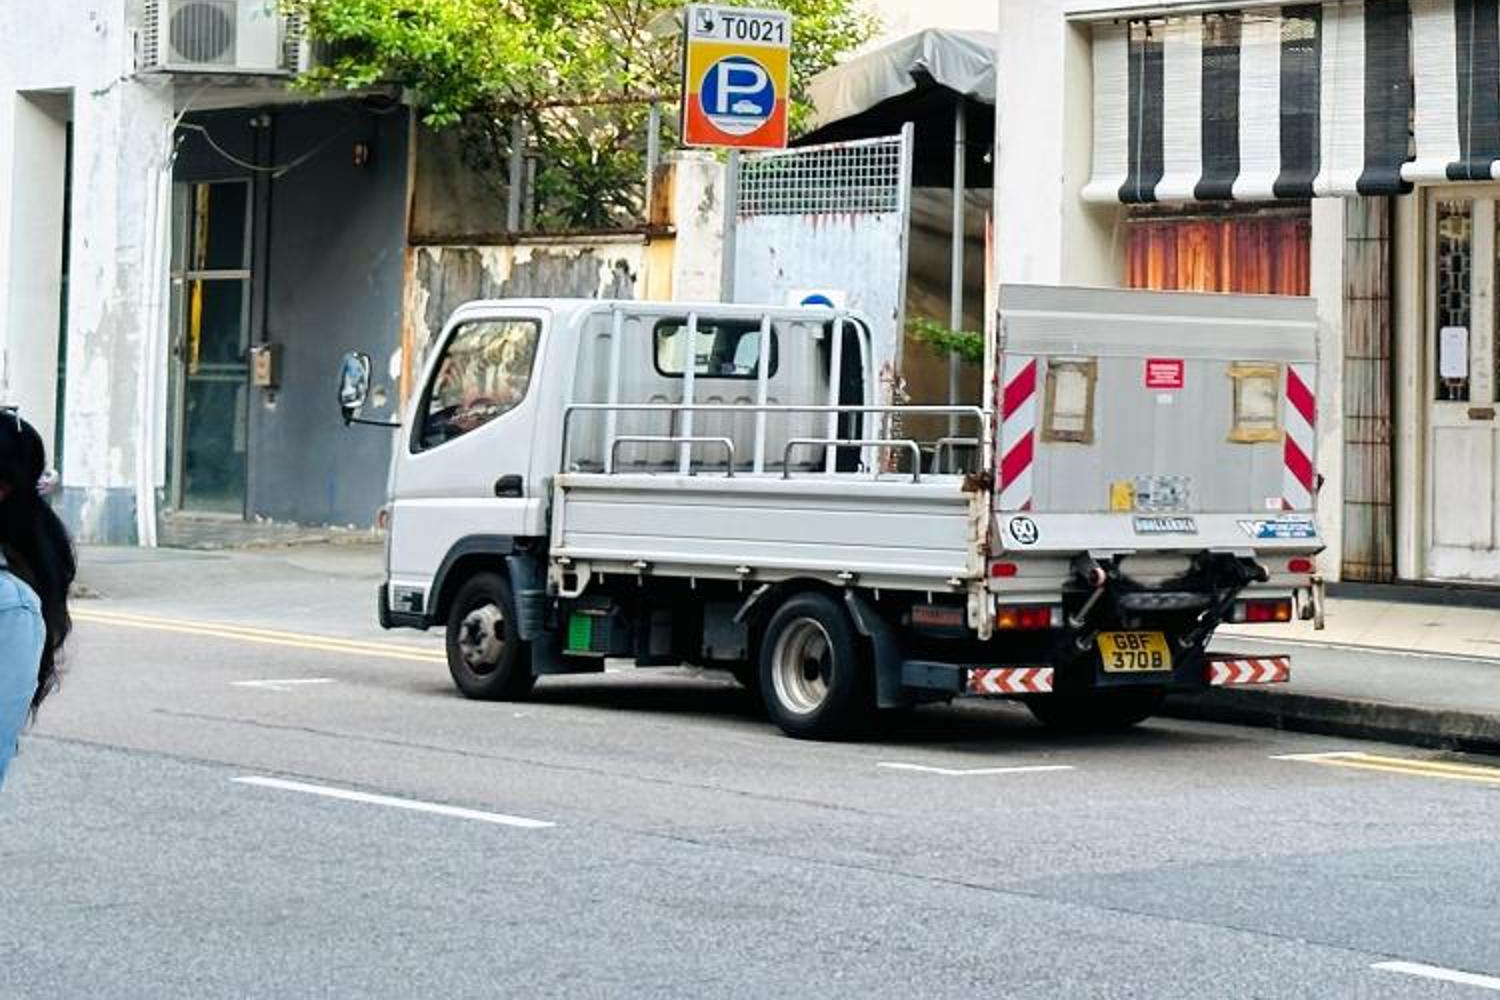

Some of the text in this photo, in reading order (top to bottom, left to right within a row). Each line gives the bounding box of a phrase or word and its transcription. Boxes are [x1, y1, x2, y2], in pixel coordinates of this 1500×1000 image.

[721, 16, 785, 43] T0021
[717, 61, 769, 113] P
[1011, 519, 1035, 536] 60
[1113, 633, 1151, 651] GBF
[1112, 651, 1163, 669] 370B
